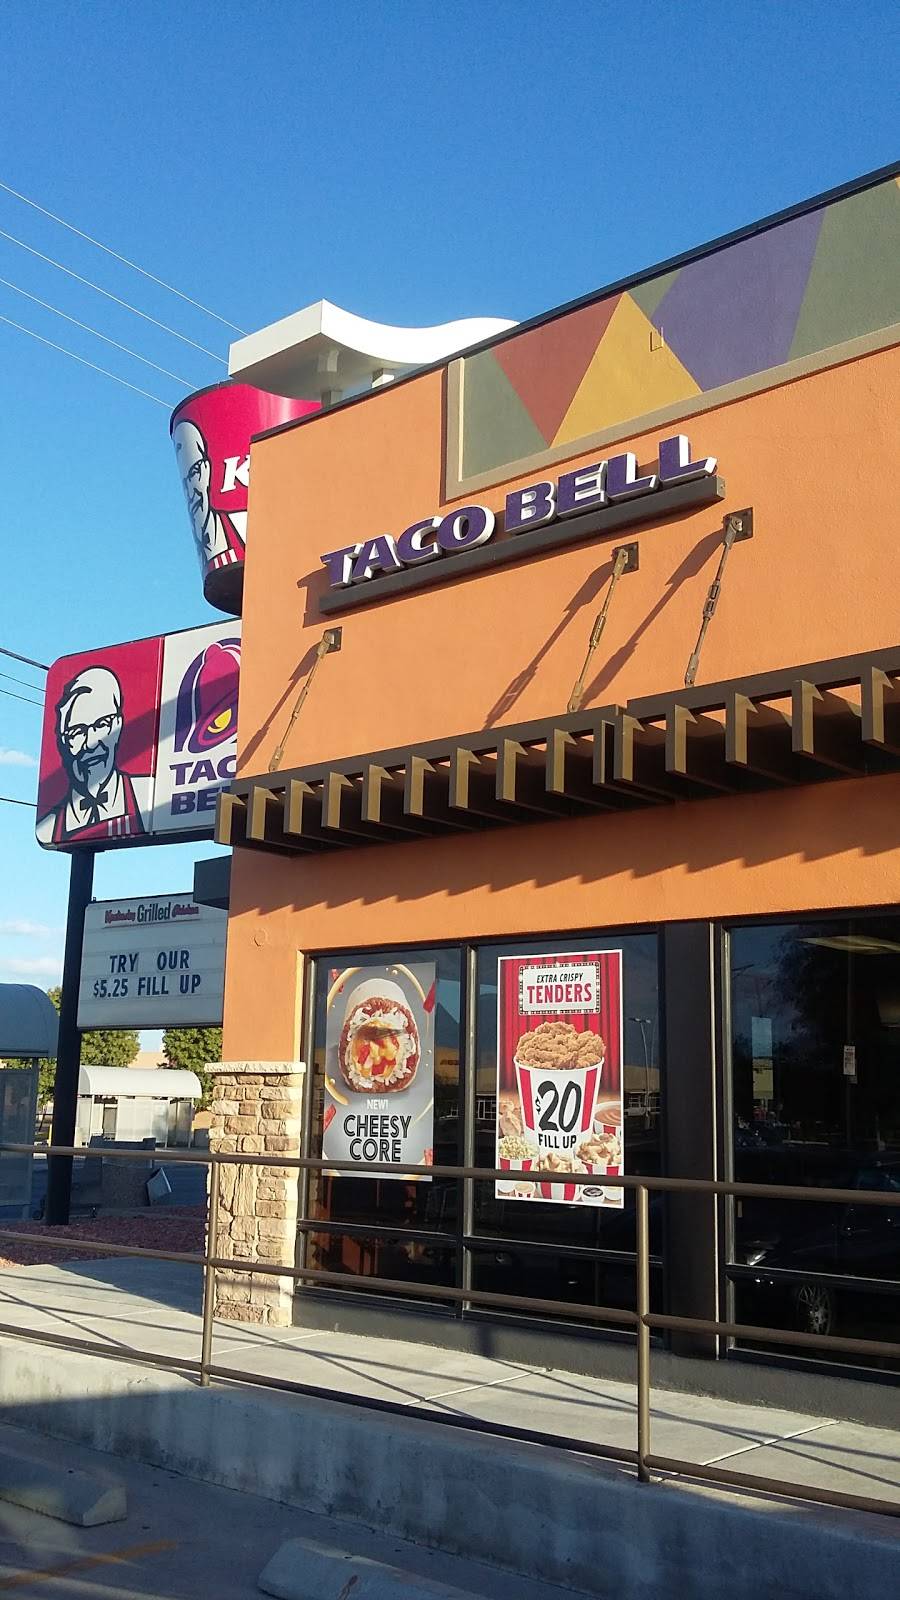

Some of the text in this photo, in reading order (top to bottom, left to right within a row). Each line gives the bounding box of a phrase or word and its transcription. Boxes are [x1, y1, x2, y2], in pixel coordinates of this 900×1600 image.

[221, 454, 250, 493] K
[320, 434, 717, 588] TACO BELL
[170, 785, 231, 816] BE
[136, 902, 171, 922] Grilled
[109, 950, 190, 973] TRY OUR
[93, 974, 201, 998] $5.25 FILL UP
[536, 972, 584, 984] EXTRA CRISPY
[526, 983, 592, 1004] TENDERS
[366, 1098, 389, 1110] NEW!
[535, 1080, 582, 1133] $20
[343, 1114, 412, 1138] CHEESY
[349, 1138, 402, 1163] CORE
[537, 1133, 577, 1149] FILL UP
